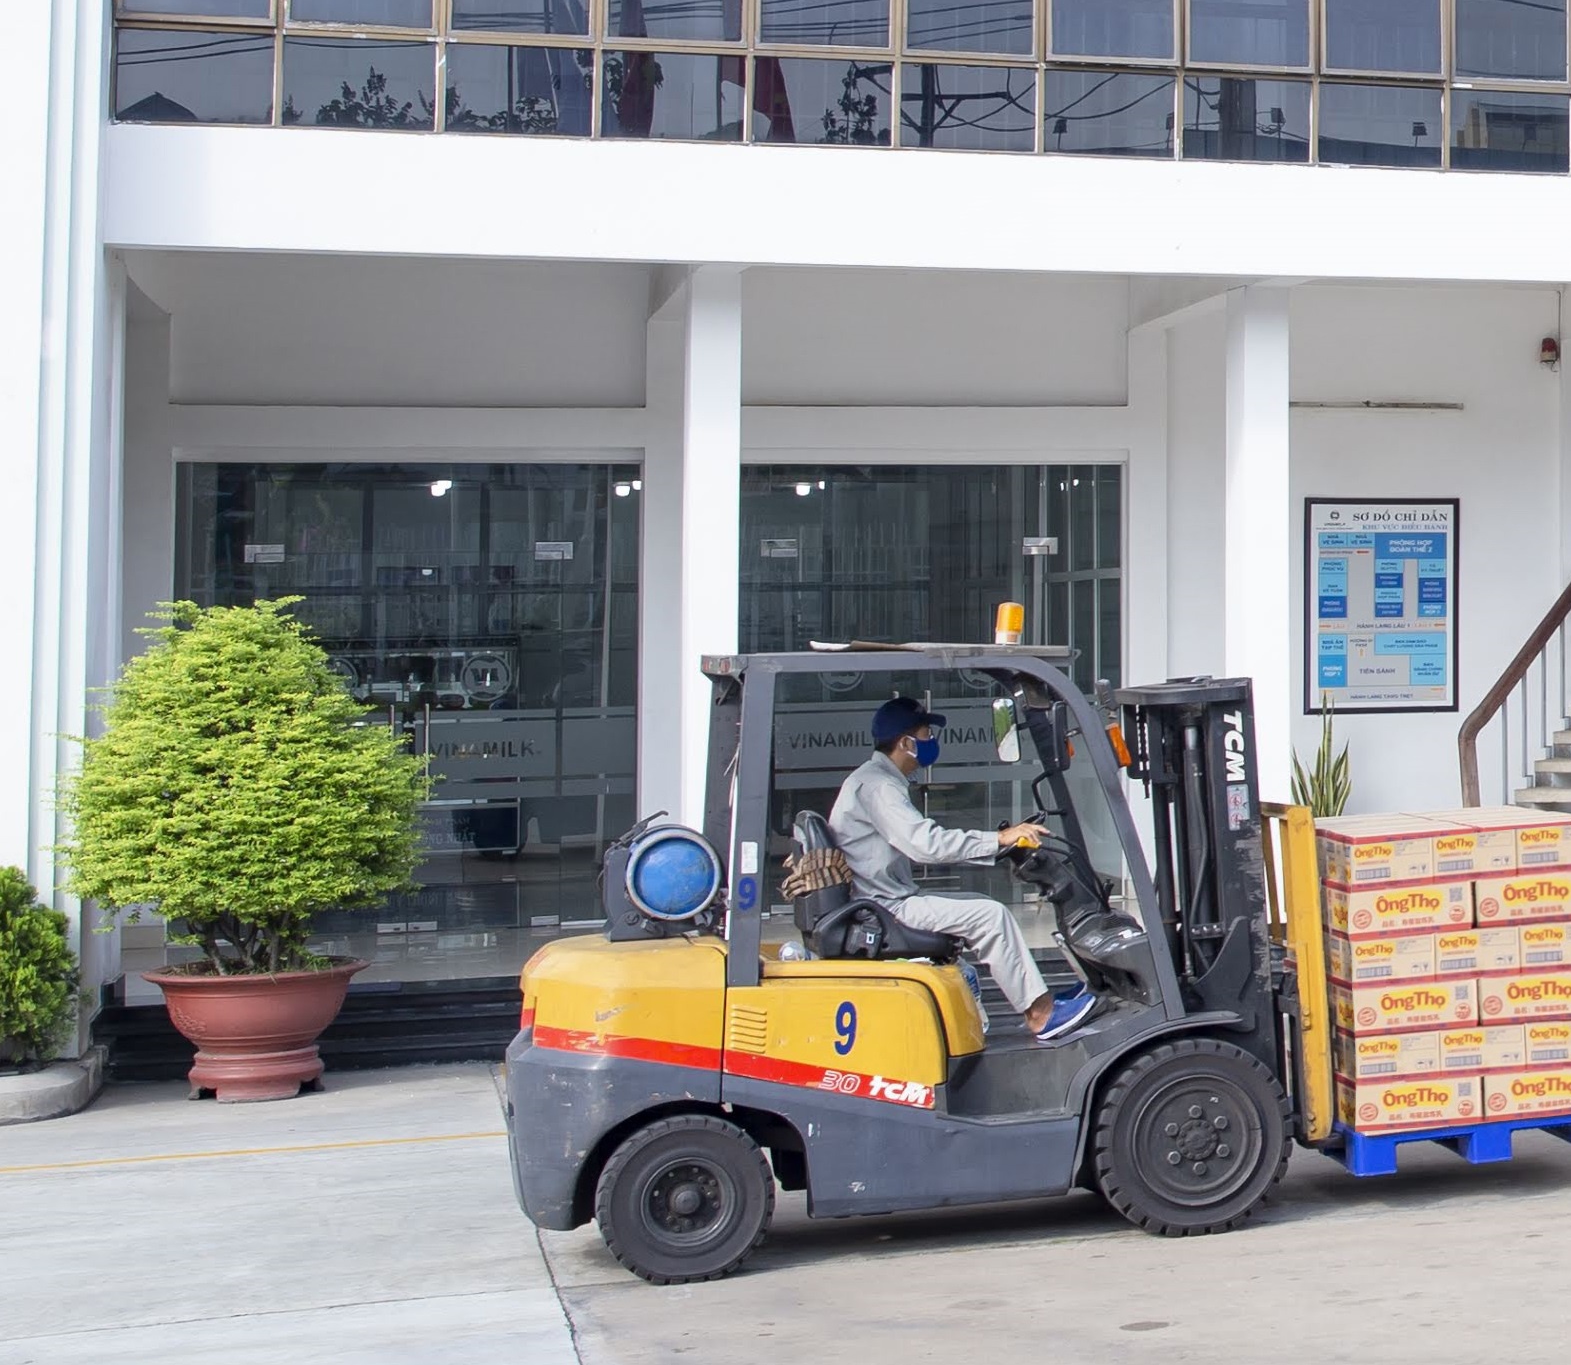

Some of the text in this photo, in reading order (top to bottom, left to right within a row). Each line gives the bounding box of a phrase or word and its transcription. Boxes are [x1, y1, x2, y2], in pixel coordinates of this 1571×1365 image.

[1352, 511, 1370, 522] SƠ
[430, 738, 535, 759] VINAMILK
[789, 730, 873, 749] VINAMIL
[1223, 709, 1246, 782] TCM
[738, 877, 757, 911] 9
[834, 1001, 858, 1056] 9
[821, 1069, 861, 1094] 30
